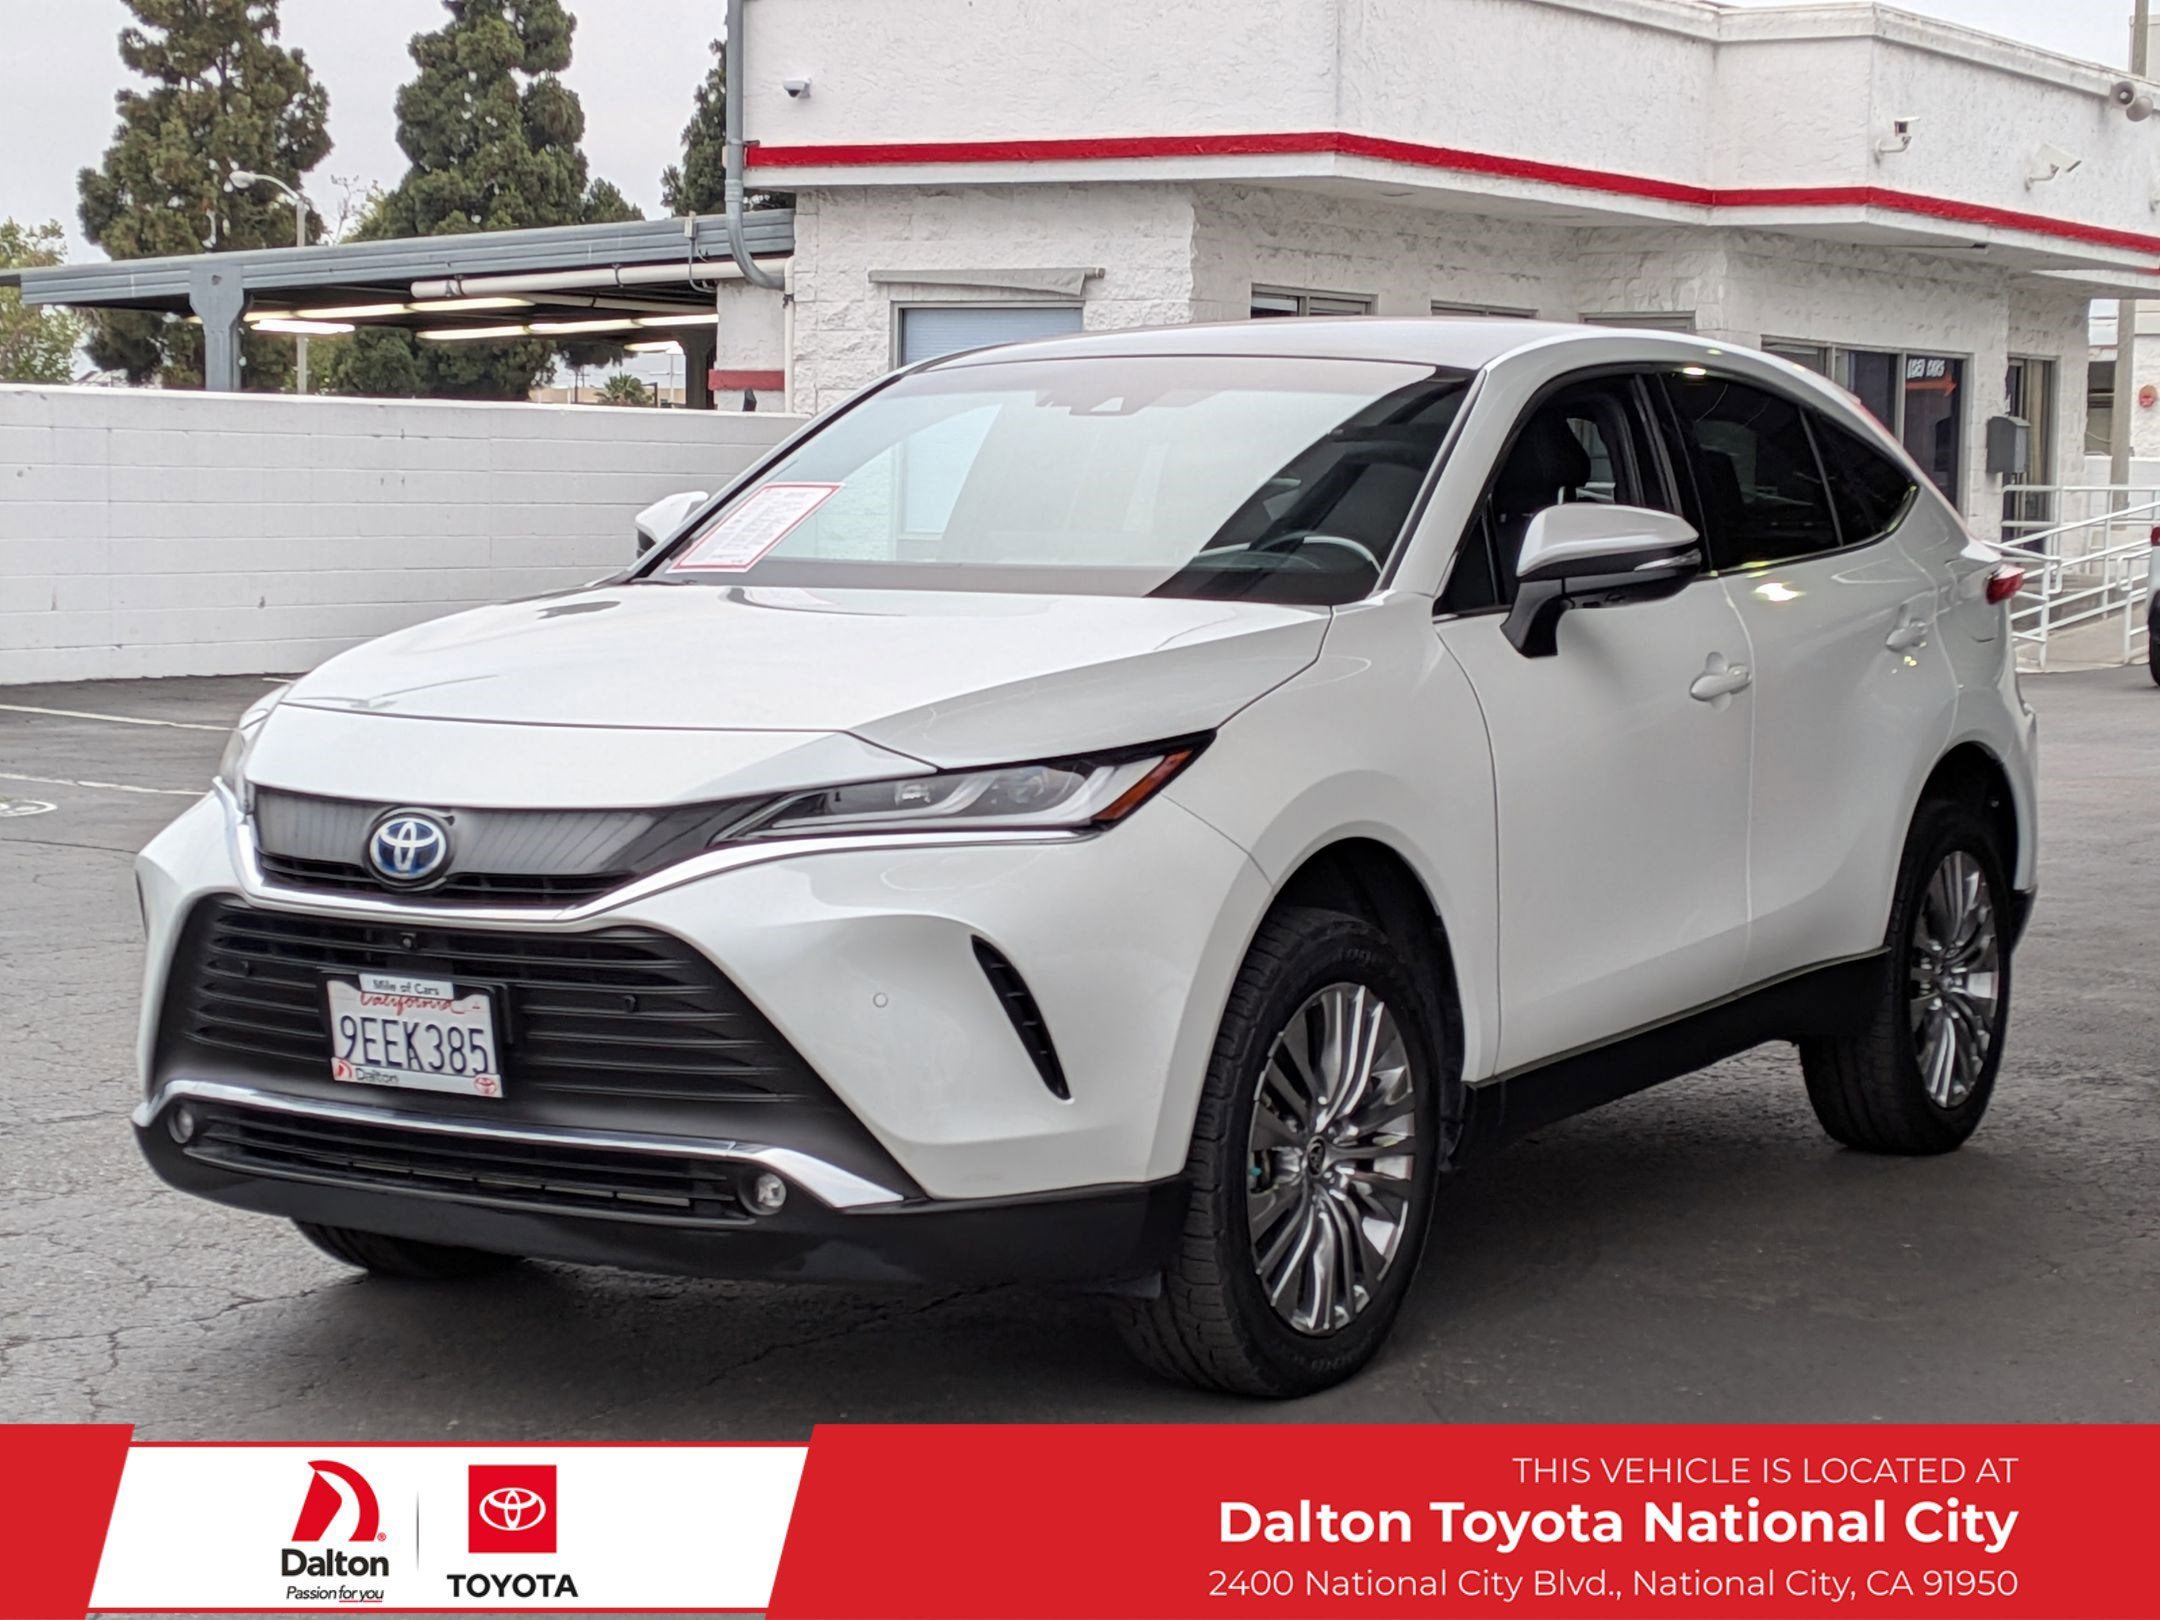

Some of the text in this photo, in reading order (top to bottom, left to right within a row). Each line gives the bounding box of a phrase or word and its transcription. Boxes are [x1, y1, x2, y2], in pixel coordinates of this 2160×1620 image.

[373, 979, 440, 996] Mile of Cars
[340, 1015, 489, 1075] 9EEK385
[355, 1067, 399, 1083] Dalton
